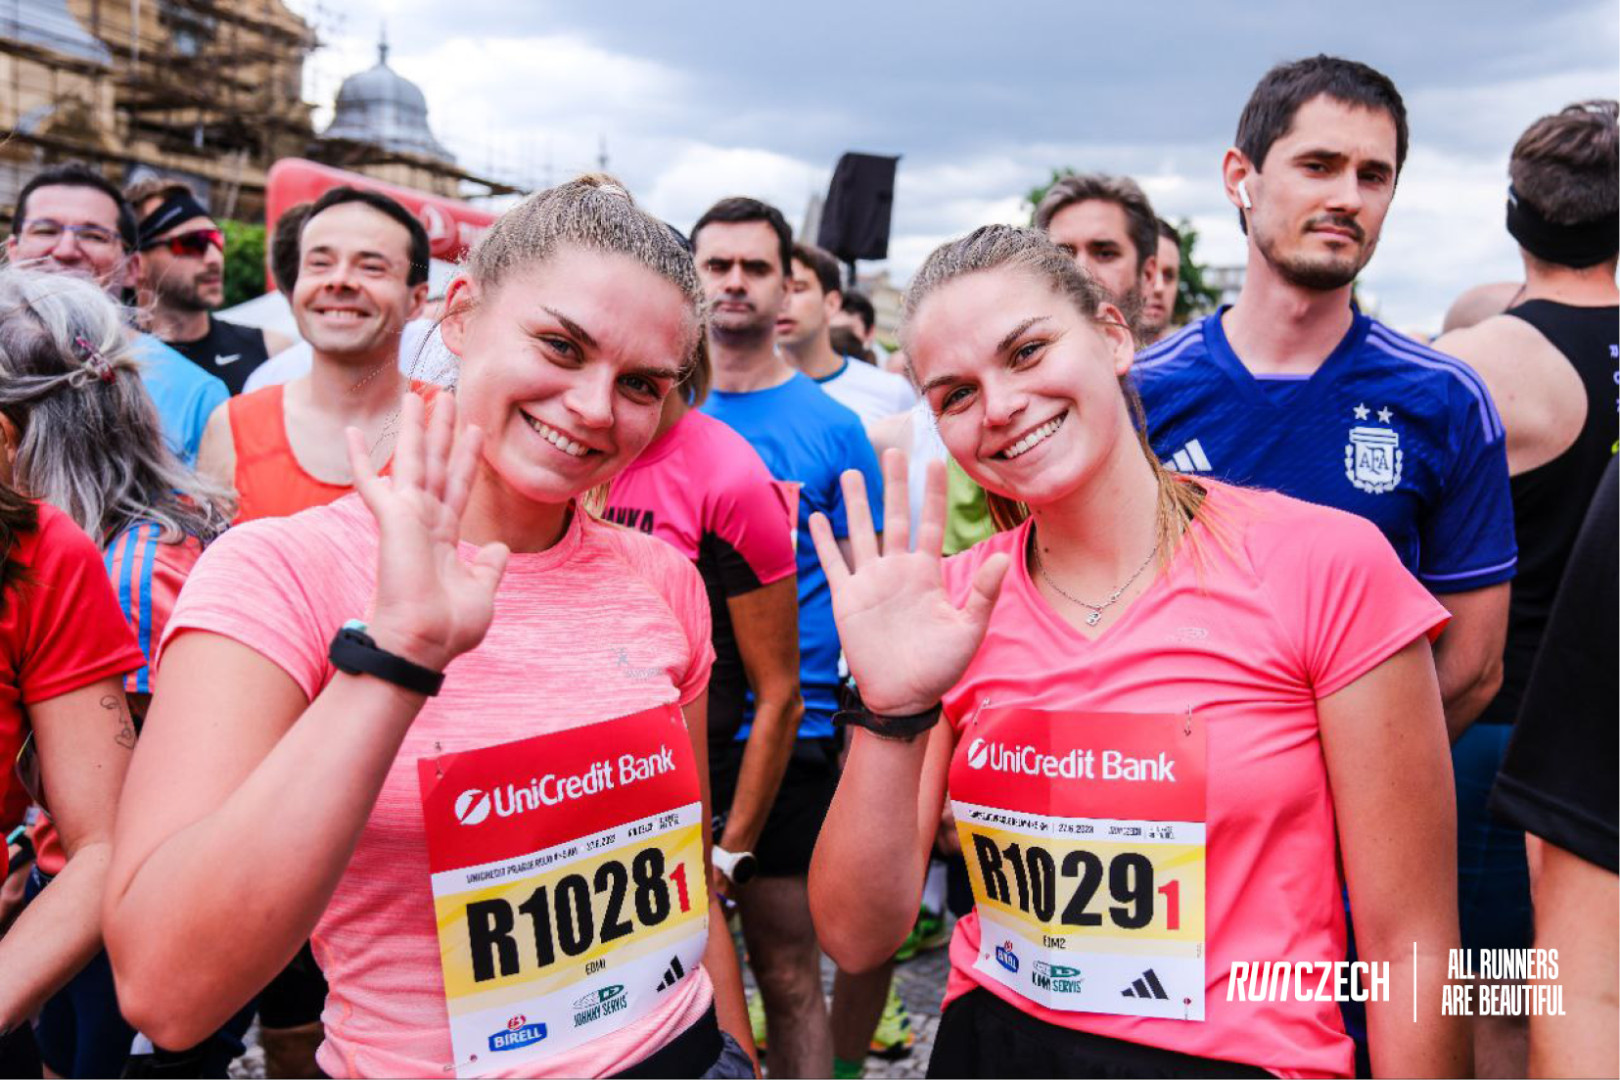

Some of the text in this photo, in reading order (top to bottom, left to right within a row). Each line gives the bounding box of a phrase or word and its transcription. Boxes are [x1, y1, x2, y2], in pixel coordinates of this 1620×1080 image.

[1358, 444, 1389, 475] AFA
[494, 744, 676, 817] UniCredit Bank
[988, 742, 1176, 782] UniCredit Bank
[971, 831, 1154, 930] R1029
[466, 847, 671, 982] R1028
[1052, 979, 1081, 993] SERVIS
[493, 1027, 543, 1049] BIRELL
